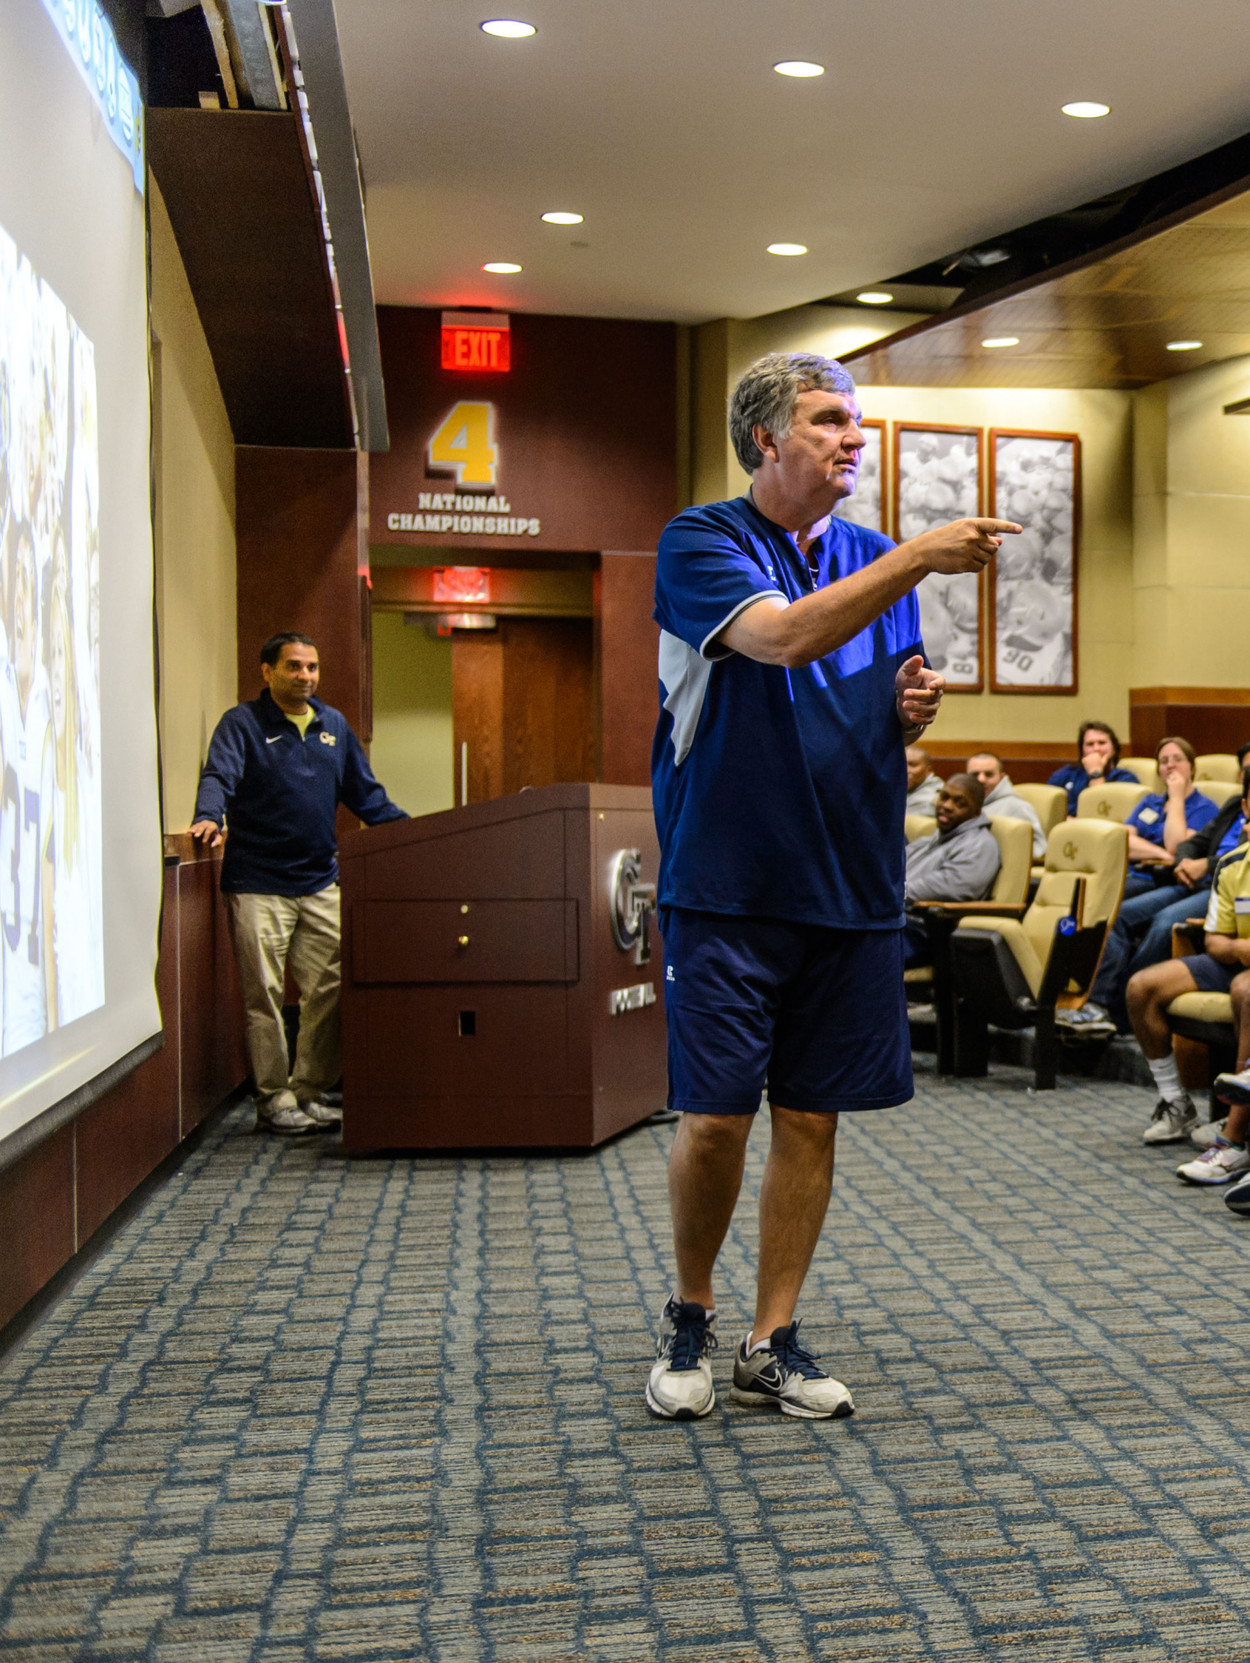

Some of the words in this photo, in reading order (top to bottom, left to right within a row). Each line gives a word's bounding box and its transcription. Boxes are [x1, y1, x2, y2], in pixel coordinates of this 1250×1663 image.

[454, 330, 502, 367] EXIT
[428, 400, 499, 487] 4
[418, 493, 511, 514] NATIONAL
[387, 513, 541, 537] CHAMPIONSHIPS
